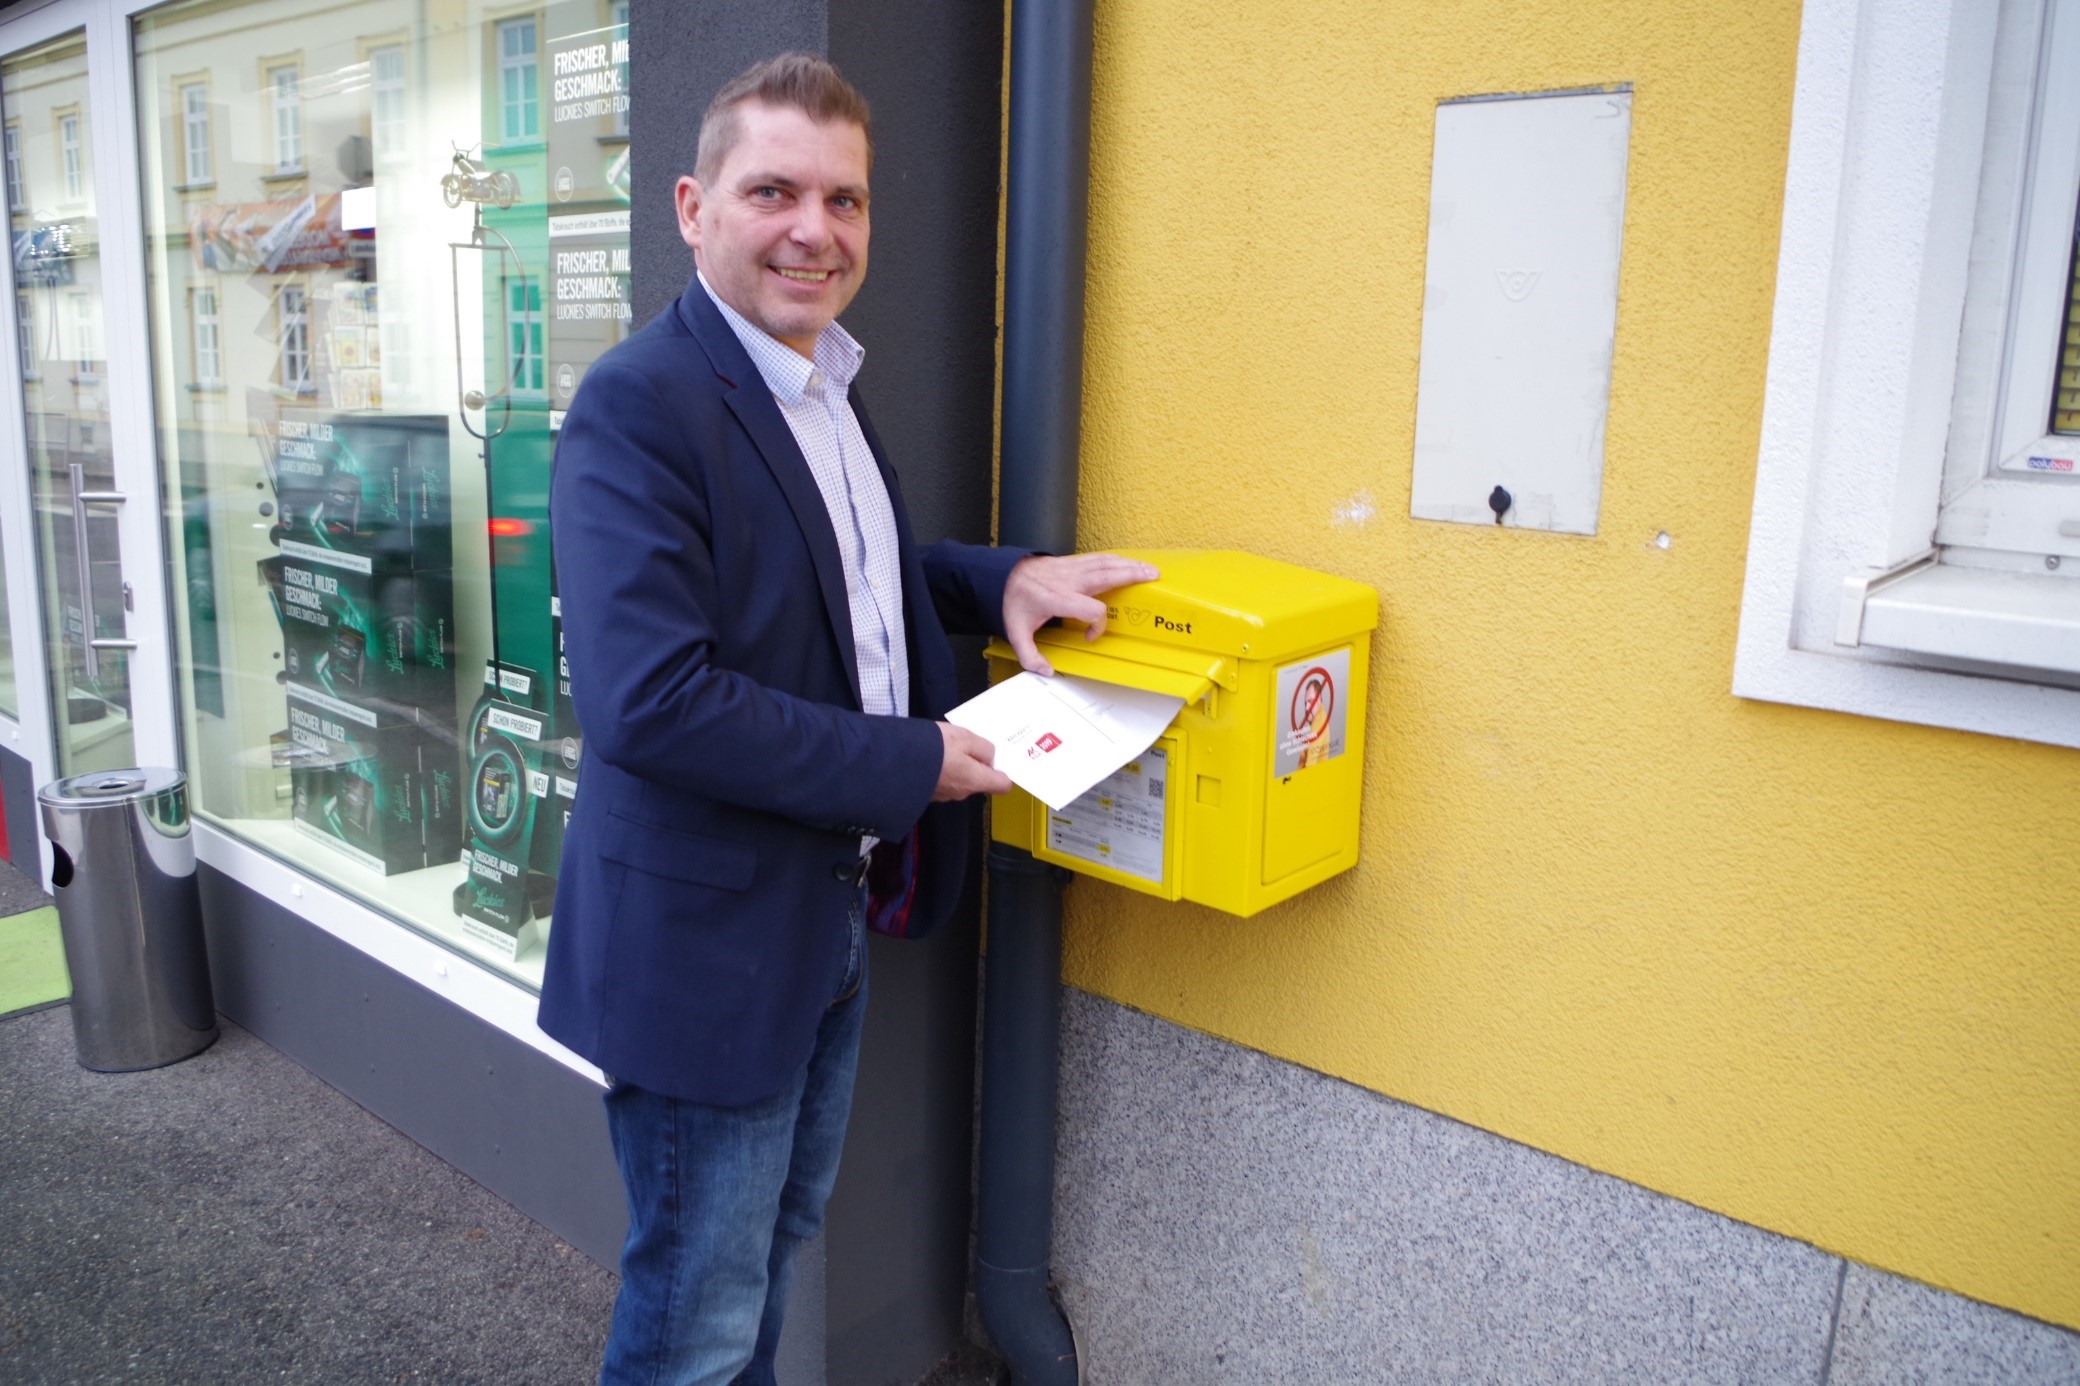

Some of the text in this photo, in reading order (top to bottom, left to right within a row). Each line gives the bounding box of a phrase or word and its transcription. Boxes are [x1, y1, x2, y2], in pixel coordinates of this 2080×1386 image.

[555, 44, 609, 76] FRISCHER,
[555, 69, 621, 102] GESCHMACK:
[555, 102, 582, 122] LUCKIES
[584, 98, 611, 118] SWITCH
[557, 250, 609, 275] FRISCHER,
[557, 276, 621, 300] GESCHMACK:
[557, 304, 584, 319] LUCKIES
[585, 303, 611, 319] SWITCH
[314, 574, 338, 595] MILDER
[1155, 615, 1192, 635] Post
[321, 719, 345, 743] MILDER
[493, 714, 538, 736] SCHON PROBIERT?
[533, 776, 546, 794] NEU
